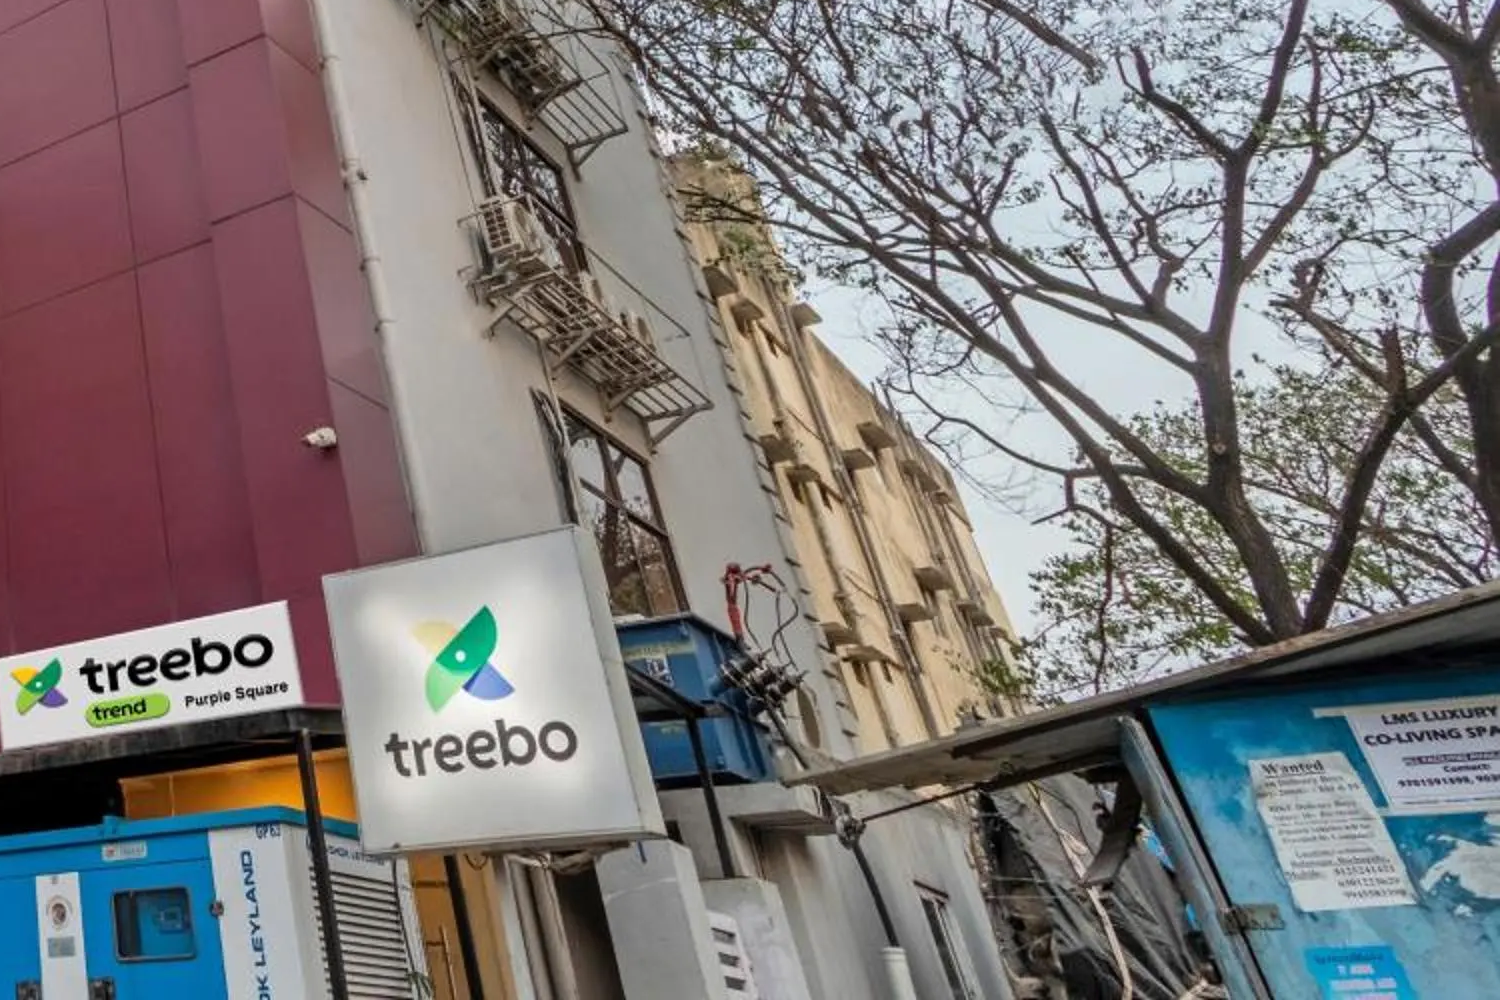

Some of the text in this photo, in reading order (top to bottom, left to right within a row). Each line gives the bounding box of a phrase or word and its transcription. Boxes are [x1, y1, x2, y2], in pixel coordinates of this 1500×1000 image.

[80, 634, 274, 694] treebo
[235, 680, 288, 701] Square
[92, 699, 147, 721] trend
[1381, 706, 1497, 725] LMS LUXURY
[1364, 727, 1462, 746] CO-LIVING
[384, 719, 578, 778] treebo
[1261, 759, 1325, 774] Wanted
[240, 850, 267, 967] LEYLAND
